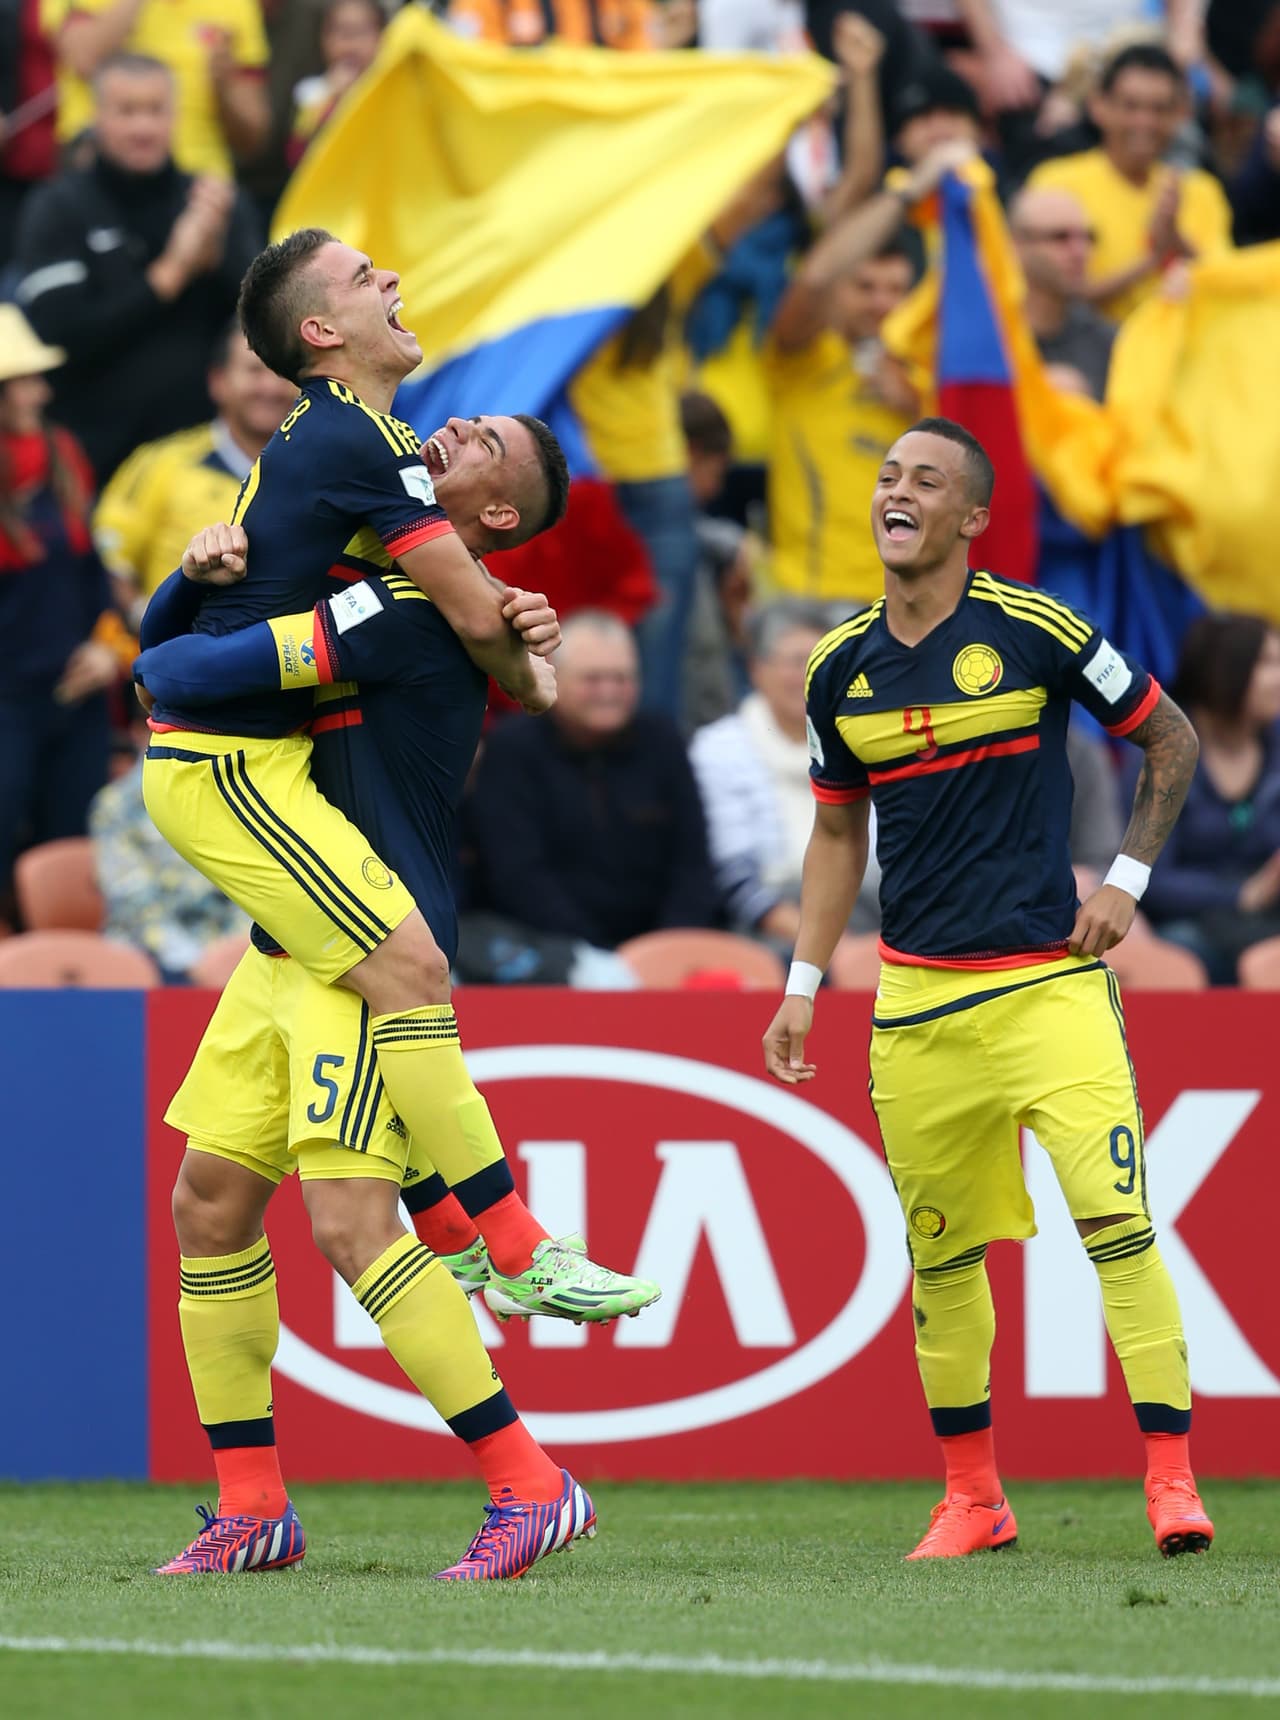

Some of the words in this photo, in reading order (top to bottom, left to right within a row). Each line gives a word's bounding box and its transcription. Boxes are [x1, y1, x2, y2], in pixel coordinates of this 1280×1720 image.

[282, 644, 293, 673] PEACE
[1096, 663, 1115, 684] FIFA
[846, 688, 874, 698] adidas
[902, 706, 938, 760] 9
[307, 1054, 345, 1124] 5
[1109, 1125, 1136, 1195] 9
